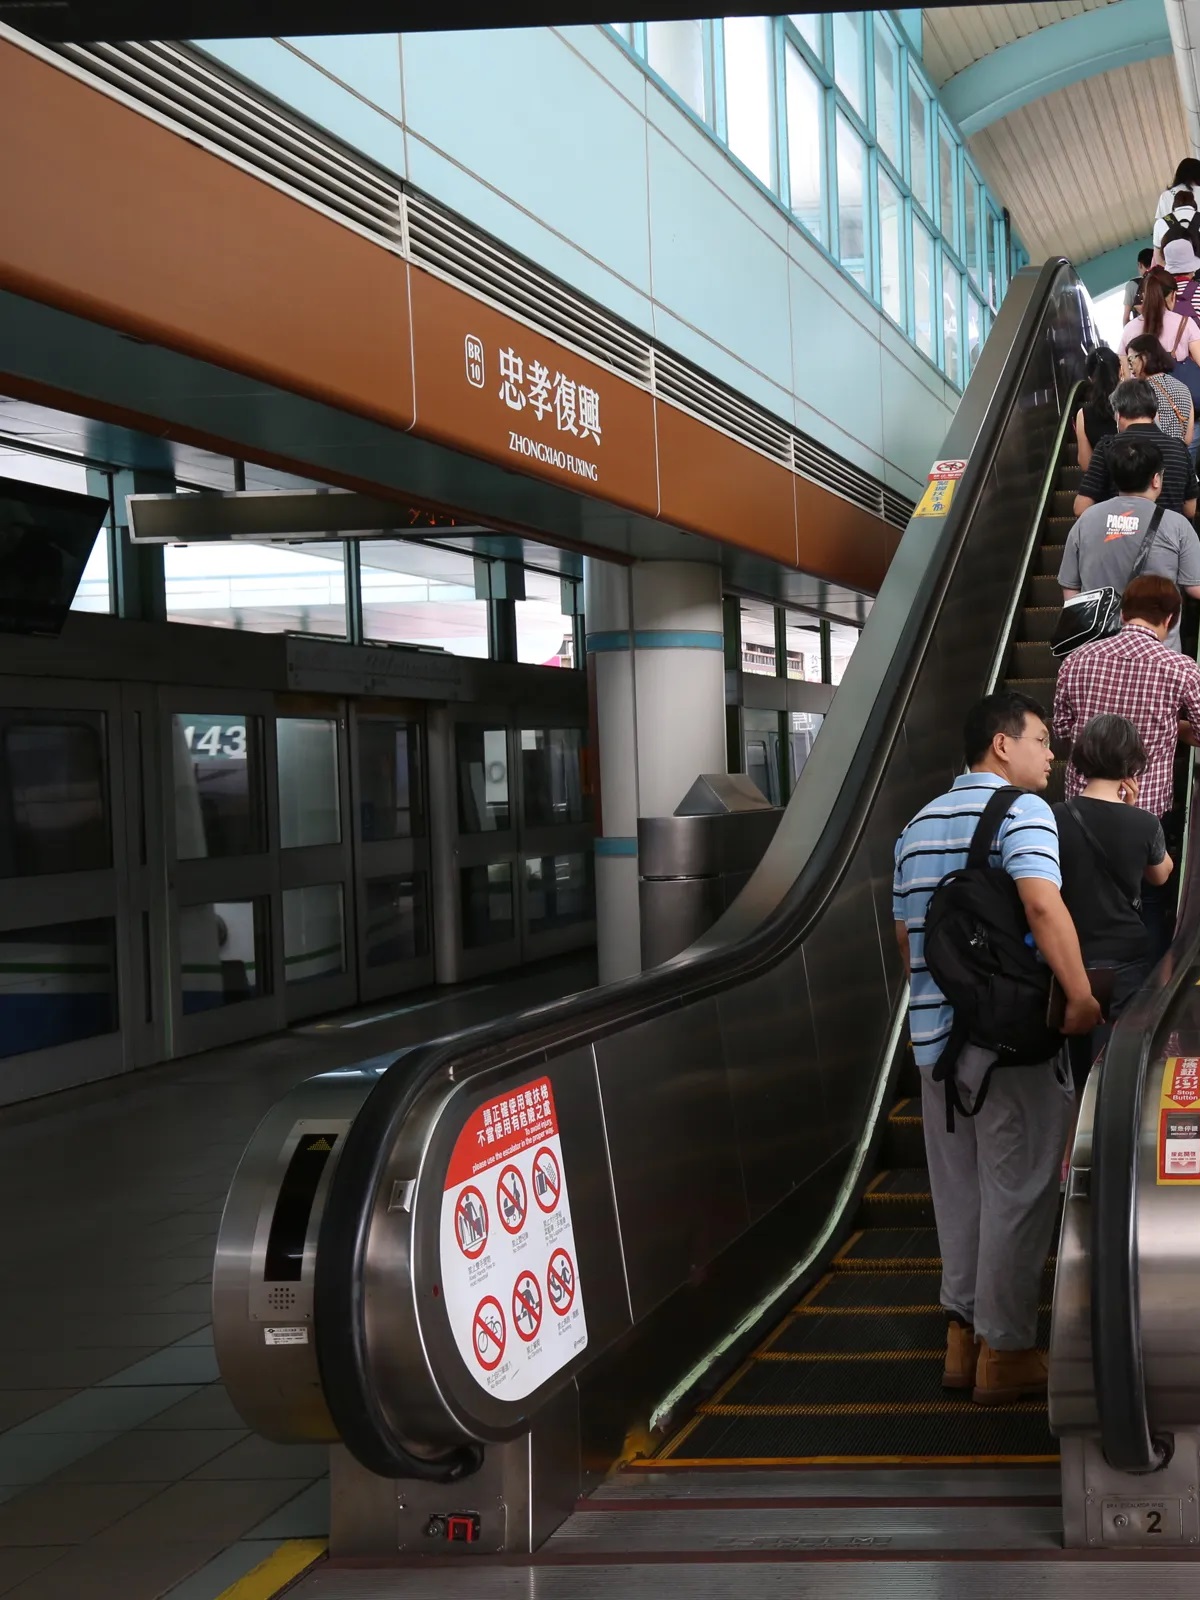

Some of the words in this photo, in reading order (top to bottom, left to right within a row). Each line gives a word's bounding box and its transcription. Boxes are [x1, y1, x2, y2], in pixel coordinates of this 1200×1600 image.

[467, 341, 482, 363] BR
[470, 363, 481, 381] 10
[498, 347, 602, 447] 忠孝復興
[508, 431, 566, 469] ZHONGXIAO
[567, 453, 599, 482] FUXING
[1106, 514, 1140, 531] PACKER
[482, 1083, 549, 1127] 請正確使用電扶梯
[476, 1100, 552, 1148] 不當使用有危險之處
[530, 1121, 541, 1133] avoid
[472, 1159, 487, 1174] please
[486, 1155, 496, 1165] use
[494, 1151, 503, 1161] the
[502, 1142, 522, 1157] escalator
[524, 1136, 533, 1146] the
[531, 1130, 547, 1144] proper
[1146, 1510, 1162, 1534] 2
